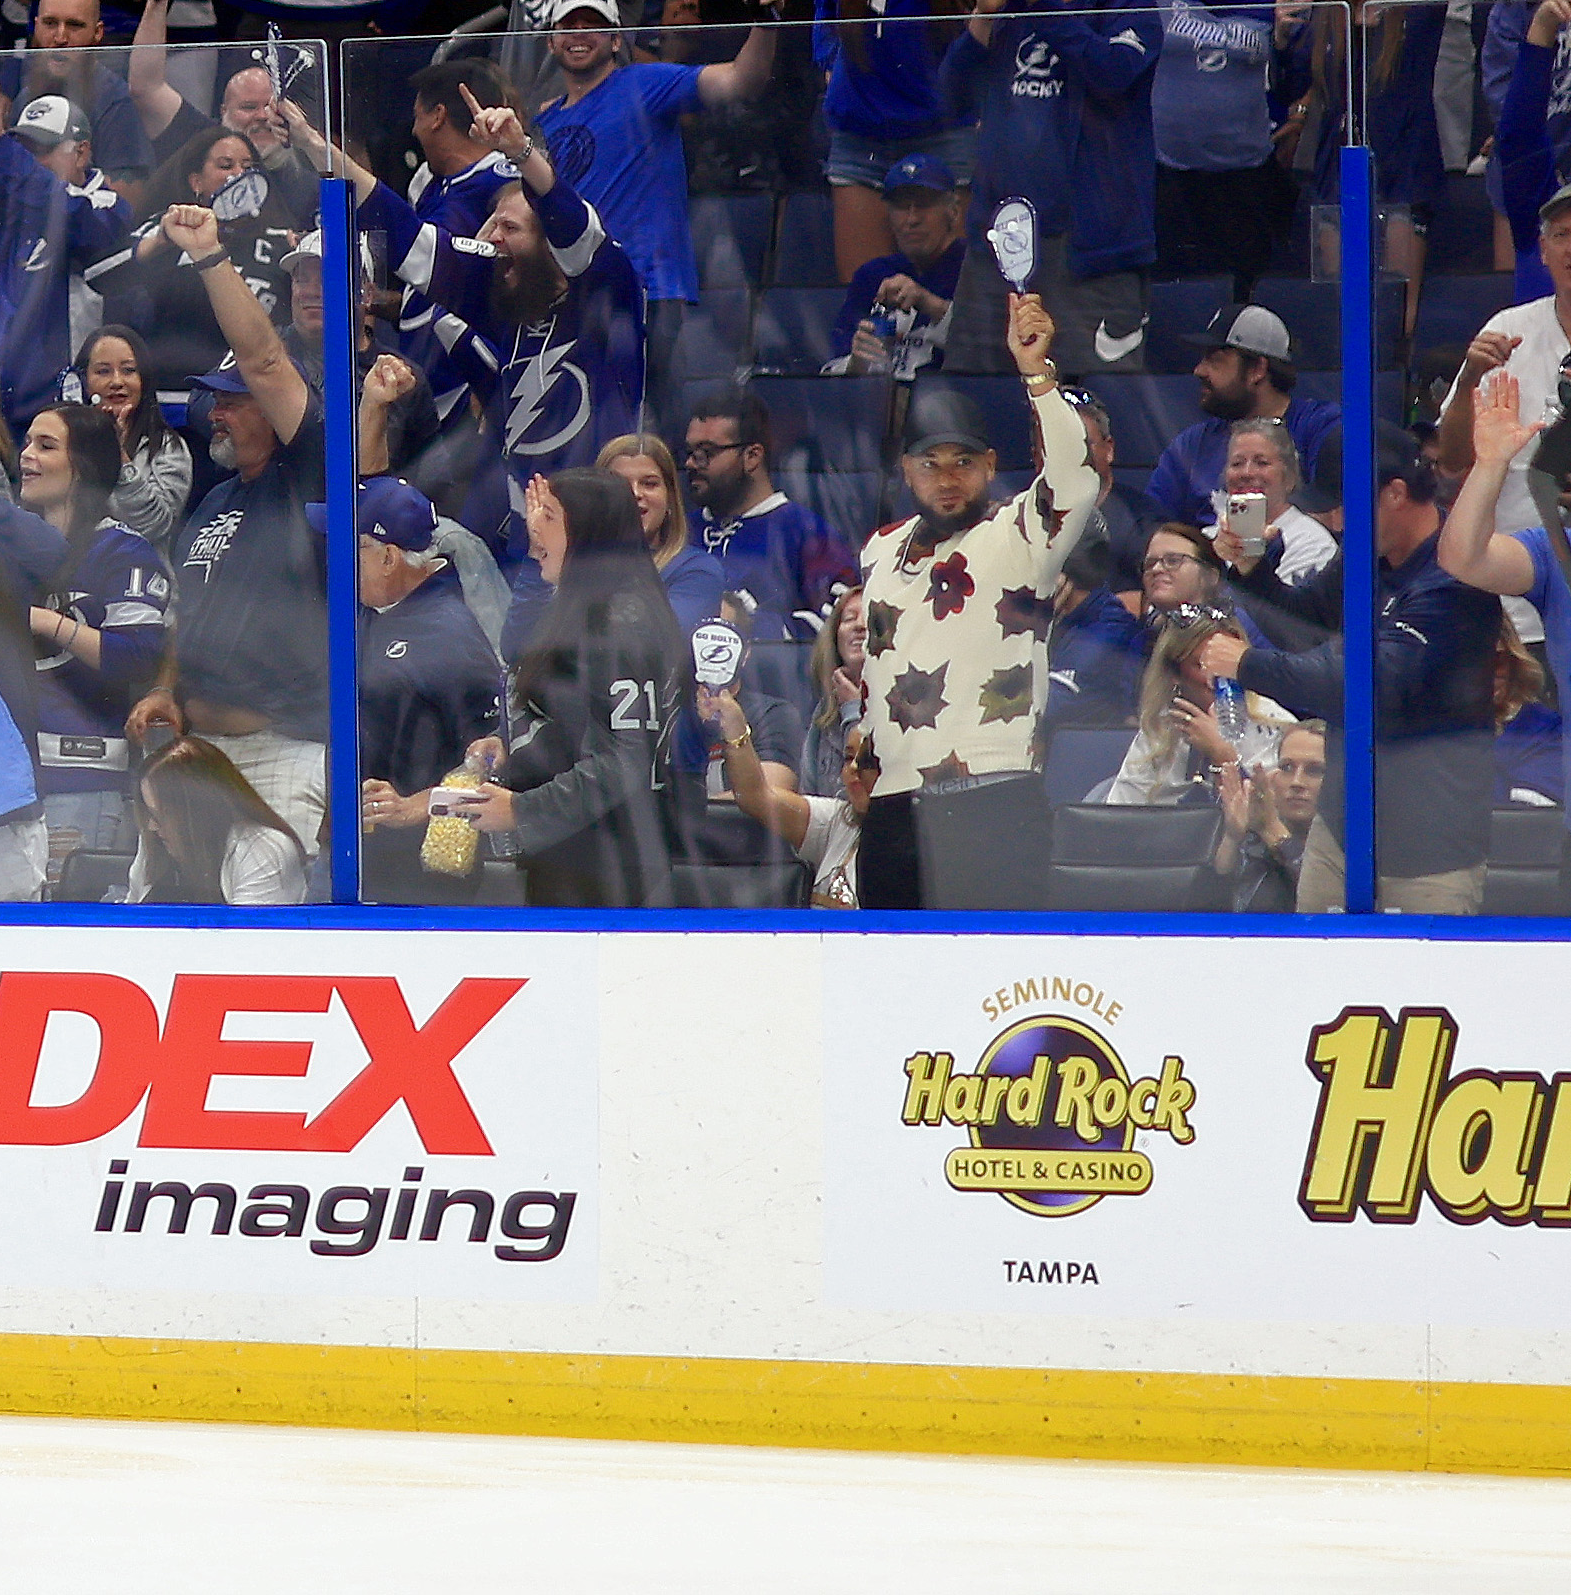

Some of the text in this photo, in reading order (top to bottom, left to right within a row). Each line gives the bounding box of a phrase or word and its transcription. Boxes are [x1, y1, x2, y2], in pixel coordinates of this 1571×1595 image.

[695, 631, 739, 645] GO BOLTS
[609, 678, 660, 732] 21
[982, 976, 1124, 1026] SEMINOLE
[900, 1051, 1197, 1145] Hard Rock
[955, 1158, 1143, 1182] HOTEL & CASINO
[95, 1159, 578, 1262] imaging
[1003, 1260, 1100, 1285] TAMPA
